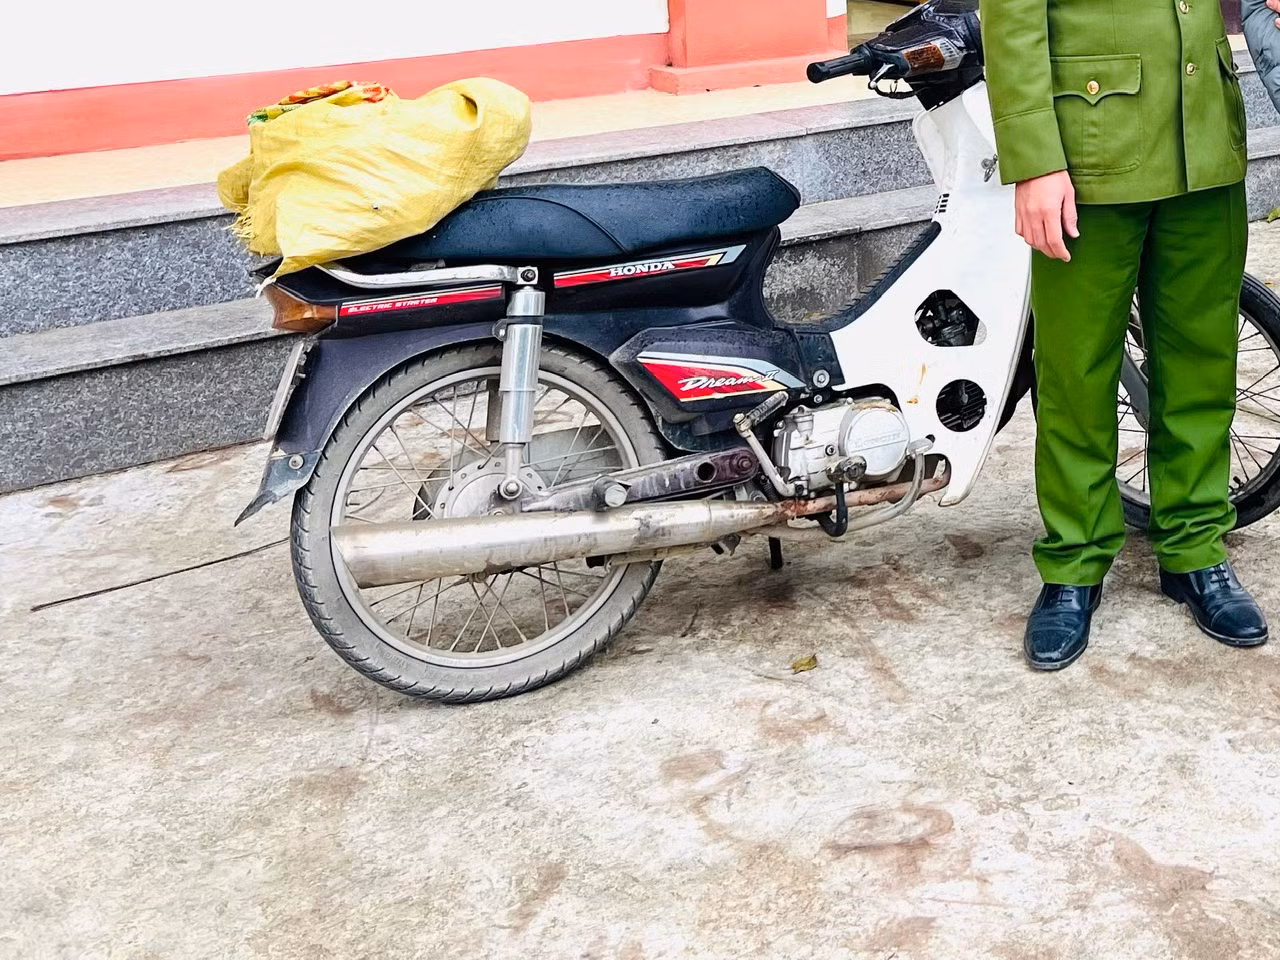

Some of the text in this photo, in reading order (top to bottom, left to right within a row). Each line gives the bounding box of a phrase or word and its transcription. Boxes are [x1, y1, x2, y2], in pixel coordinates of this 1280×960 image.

[609, 261, 675, 277] HONDA
[348, 298, 438, 313] ELECTRIC STARTER
